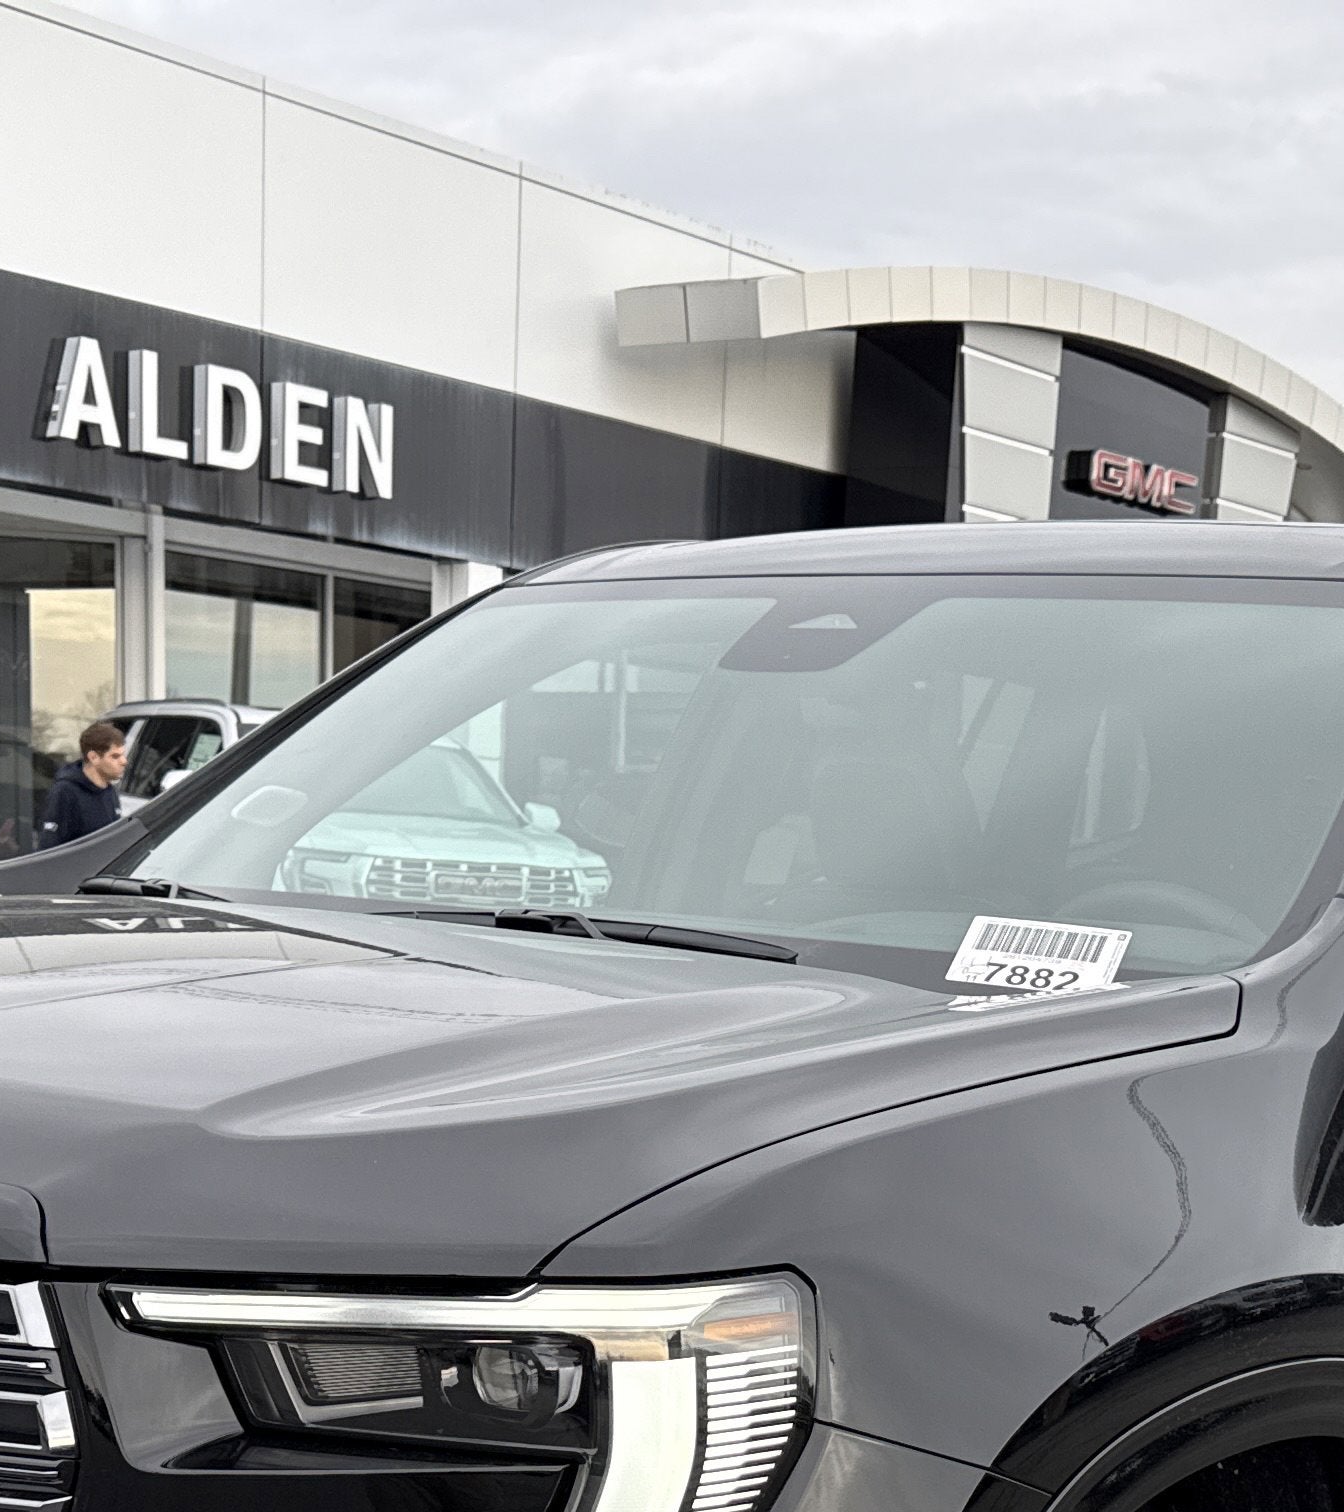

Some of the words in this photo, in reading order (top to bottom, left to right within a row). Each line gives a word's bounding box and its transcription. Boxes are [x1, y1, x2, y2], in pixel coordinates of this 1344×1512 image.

[47, 336, 394, 499] ALDEN
[1091, 448, 1199, 515] GMC
[983, 961, 1080, 990] 7882
